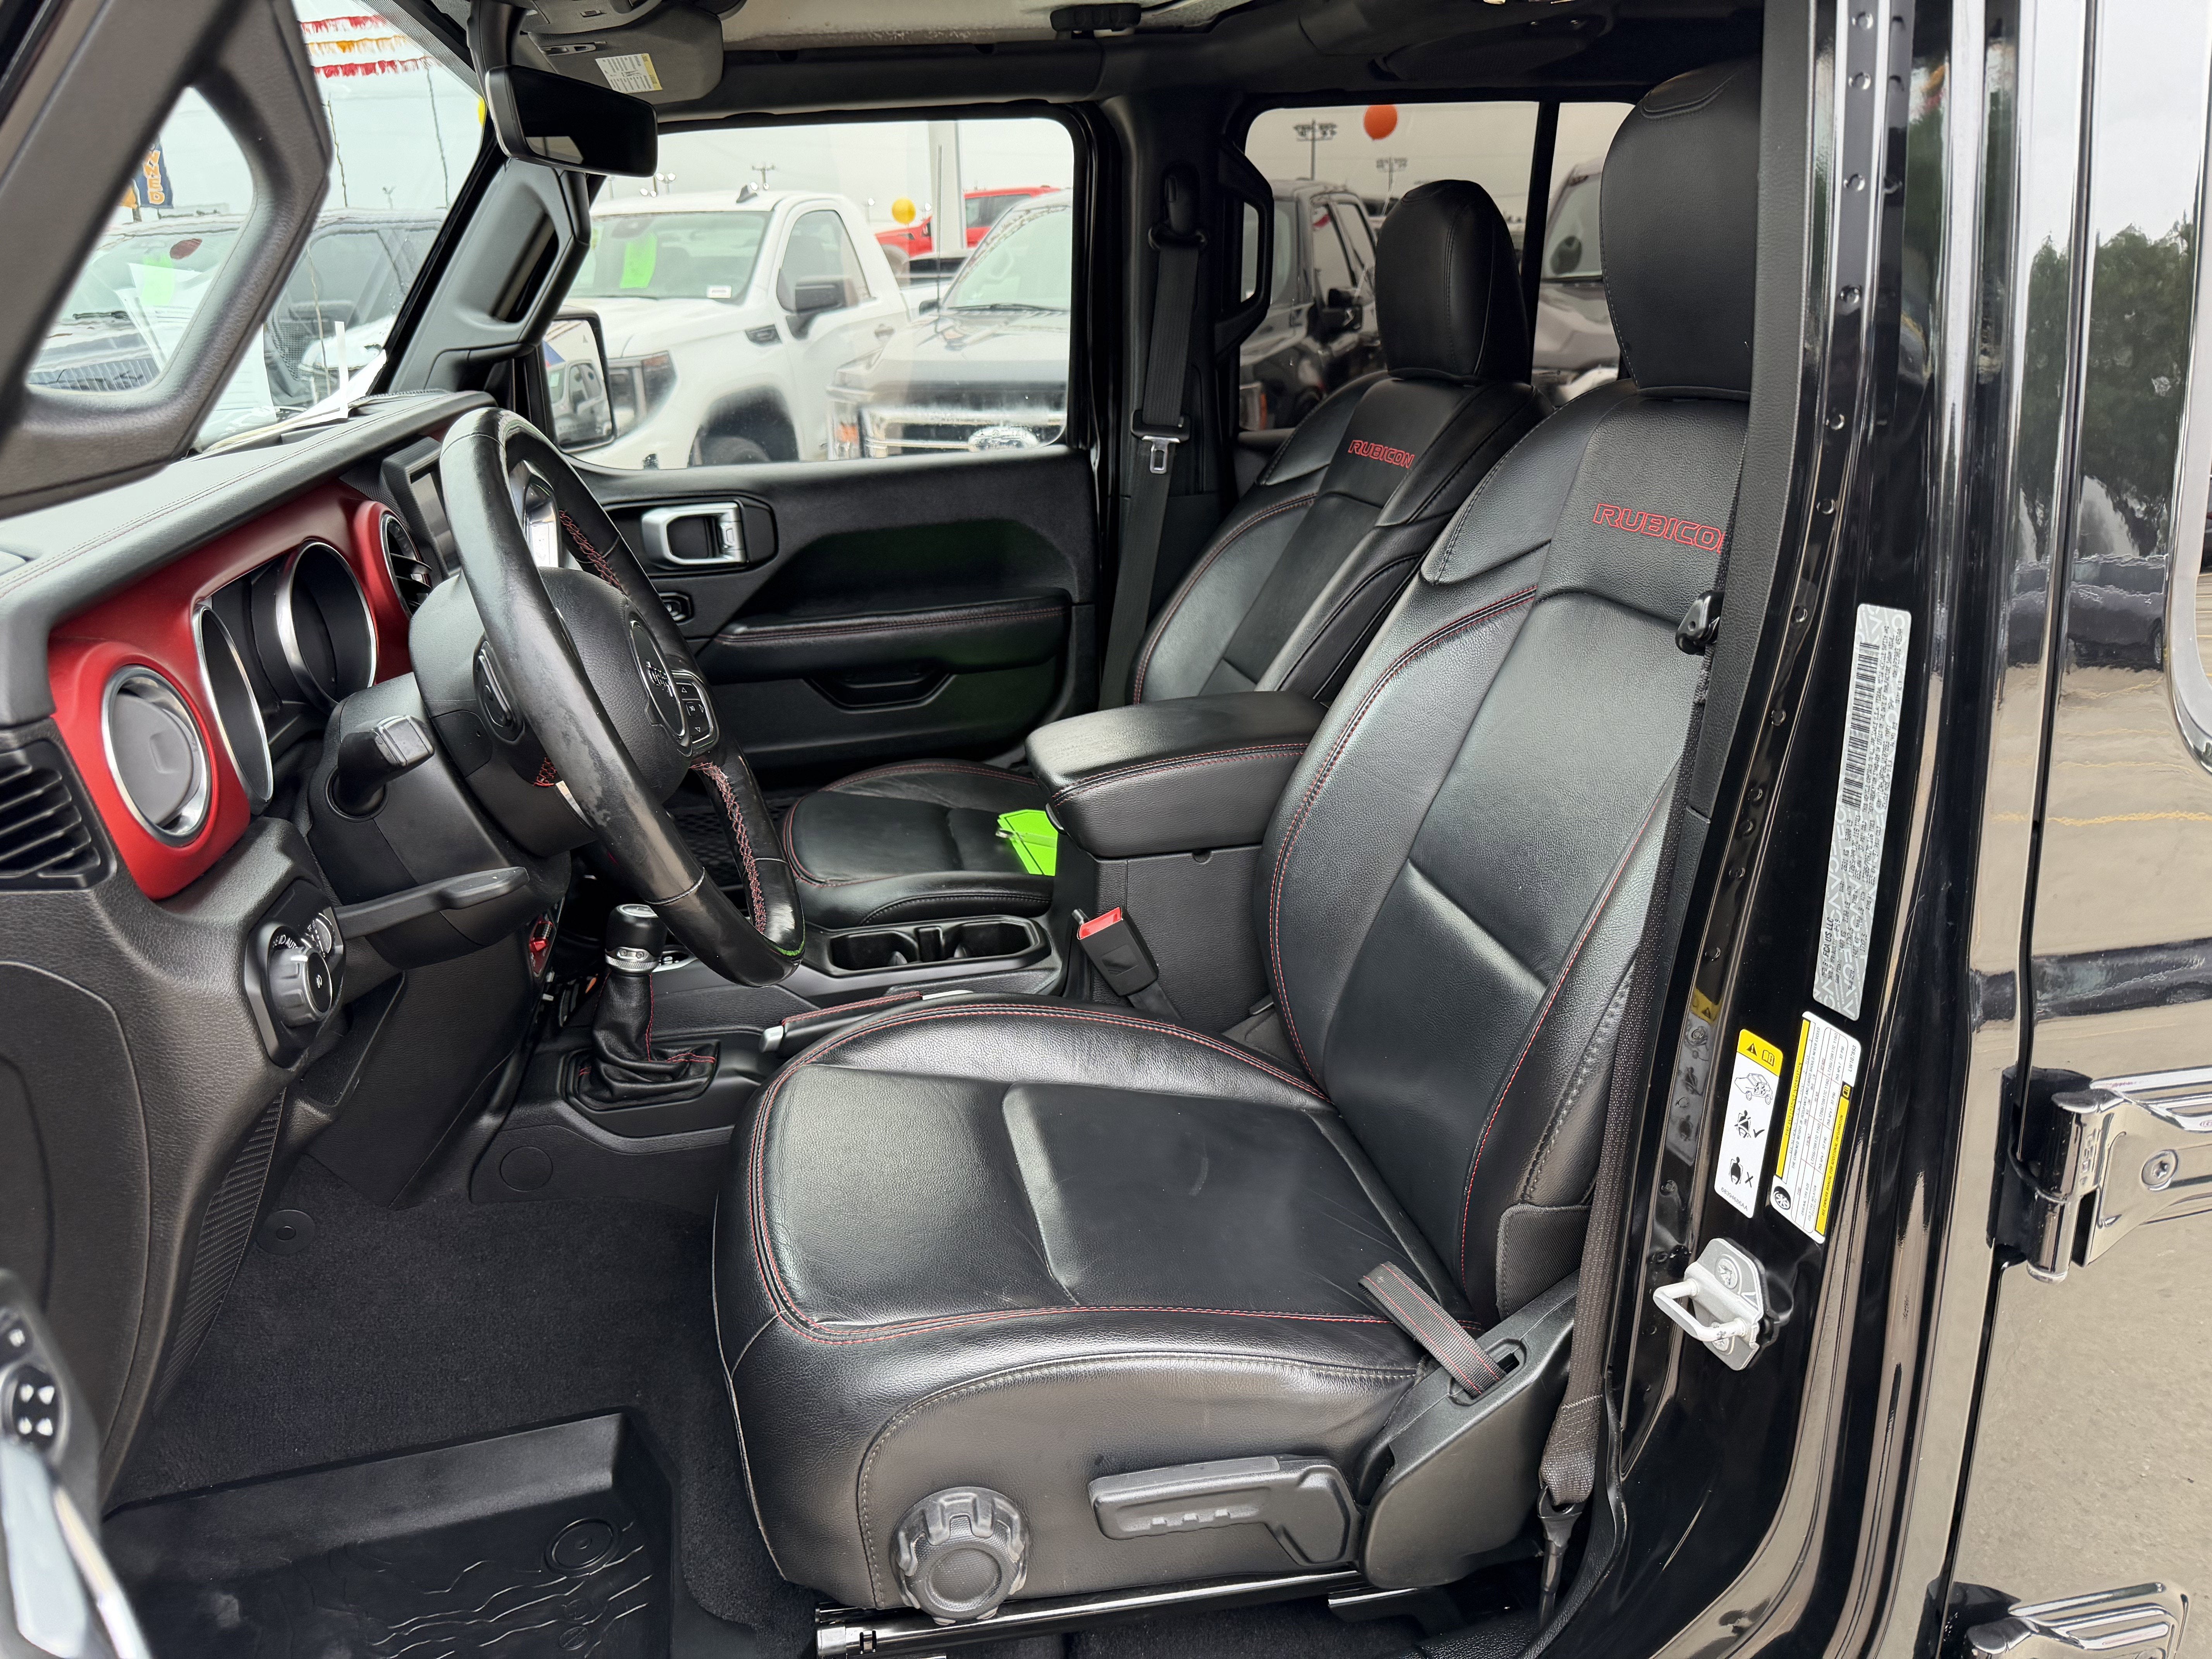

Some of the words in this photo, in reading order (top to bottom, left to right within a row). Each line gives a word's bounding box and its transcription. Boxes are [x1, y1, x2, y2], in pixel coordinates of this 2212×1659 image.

[1348, 440, 1415, 469] RUBICON
[1592, 503, 1726, 554] RUBICO
[1843, 848, 1849, 857] KG
[1846, 818, 1853, 826] LB
[1872, 849, 1879, 857] 37
[1844, 900, 1850, 909] LB
[1858, 906, 1864, 915] LB
[1826, 916, 1834, 931] LLC
[1824, 931, 1832, 943] US
[1822, 957, 1828, 967] BY
[1848, 1044, 1856, 1072] LW107893
[1835, 1114, 1843, 1142] INFORMATION
